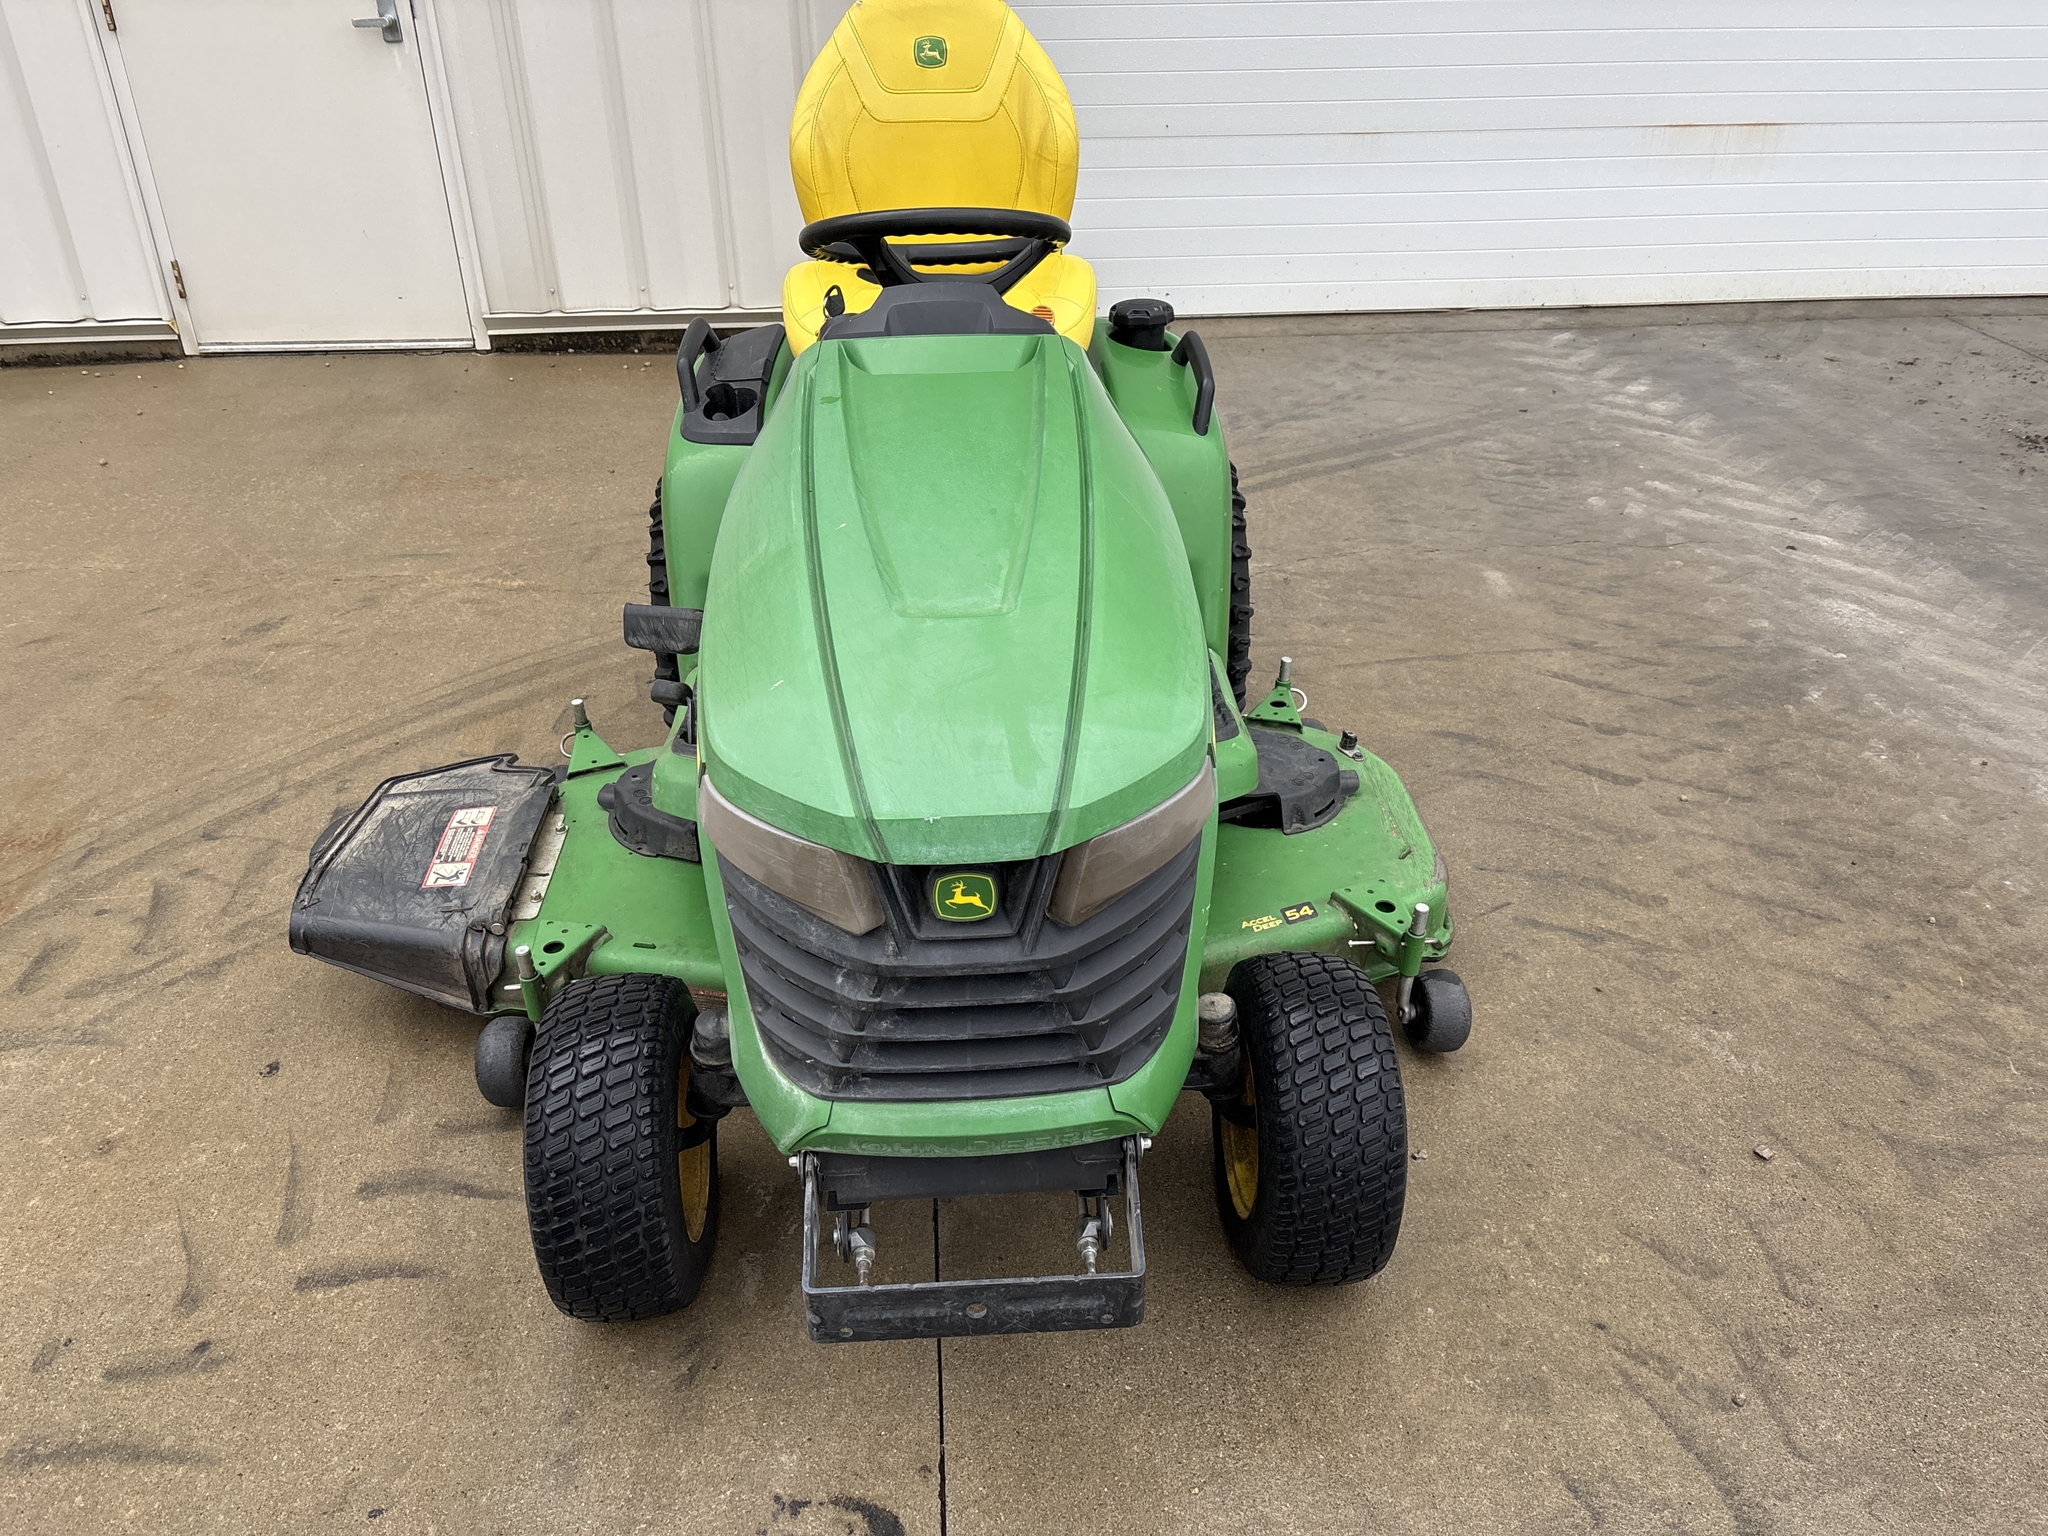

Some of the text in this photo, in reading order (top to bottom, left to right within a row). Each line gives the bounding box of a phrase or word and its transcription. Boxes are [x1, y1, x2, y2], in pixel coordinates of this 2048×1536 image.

[468, 834, 484, 859] DANGER
[1284, 905, 1314, 920] 54
[1241, 914, 1277, 929] ACCEL
[1252, 919, 1283, 933] DEEP
[836, 1127, 1110, 1156] JOHN DEERE
